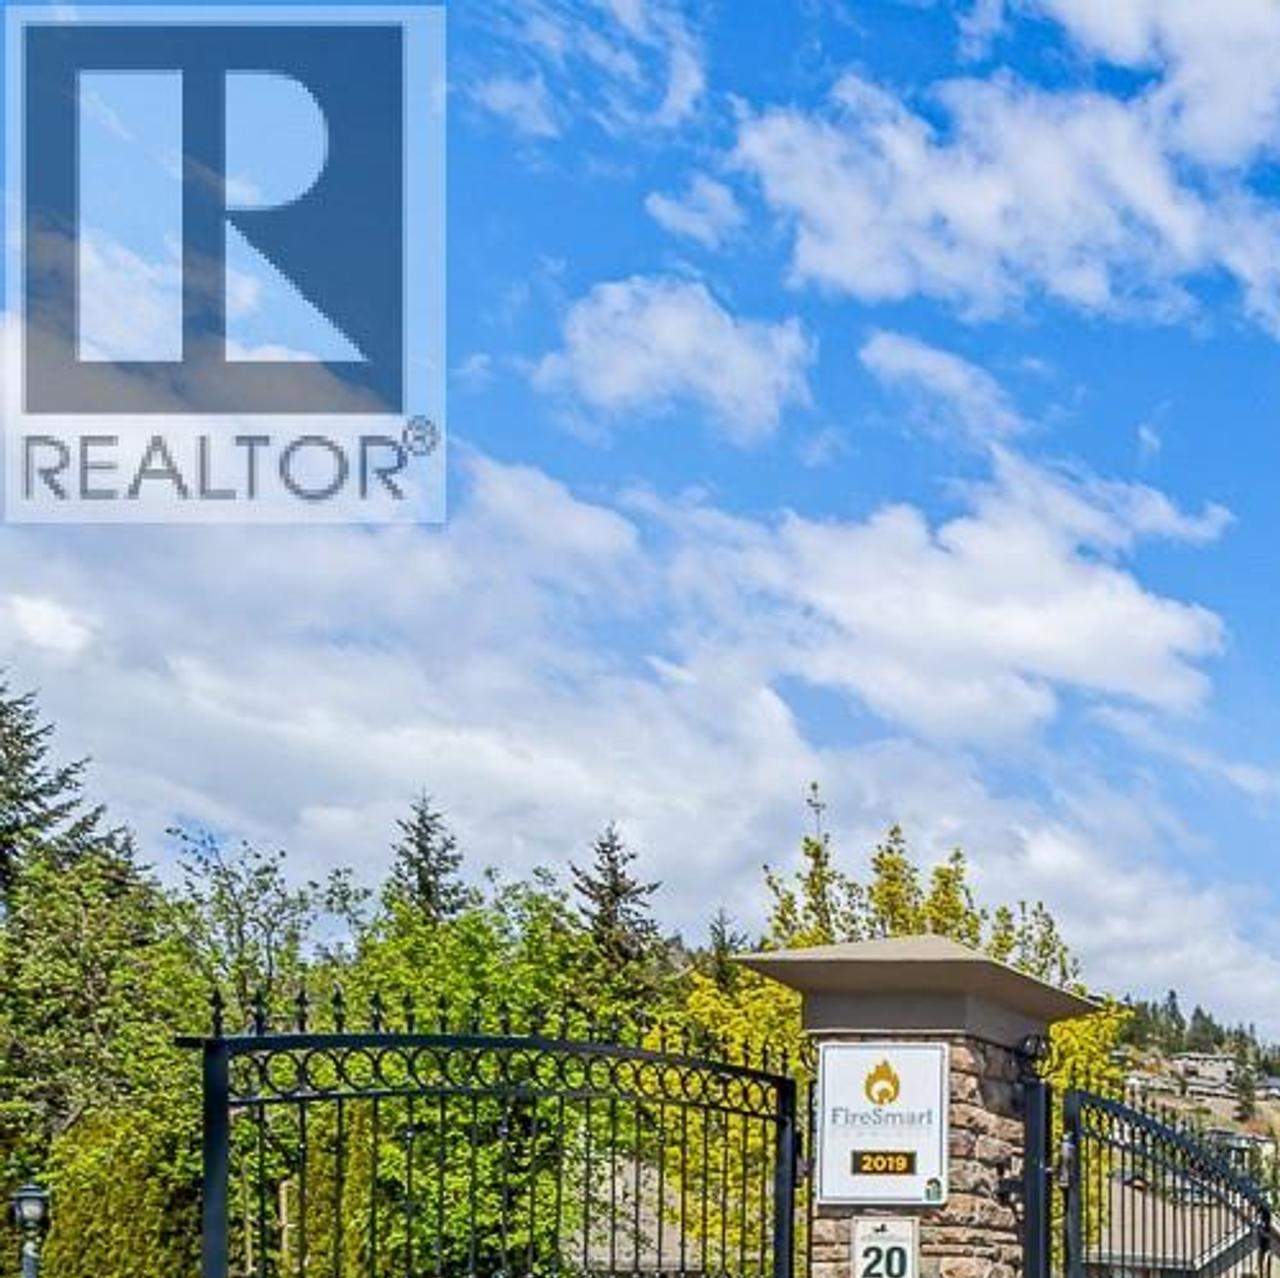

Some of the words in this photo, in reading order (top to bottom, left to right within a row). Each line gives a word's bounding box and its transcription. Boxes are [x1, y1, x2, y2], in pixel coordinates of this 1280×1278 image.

[830, 1106, 933, 1125] FireSmart
[861, 1154, 908, 1172] 2019
[861, 1245, 907, 1278] 20
